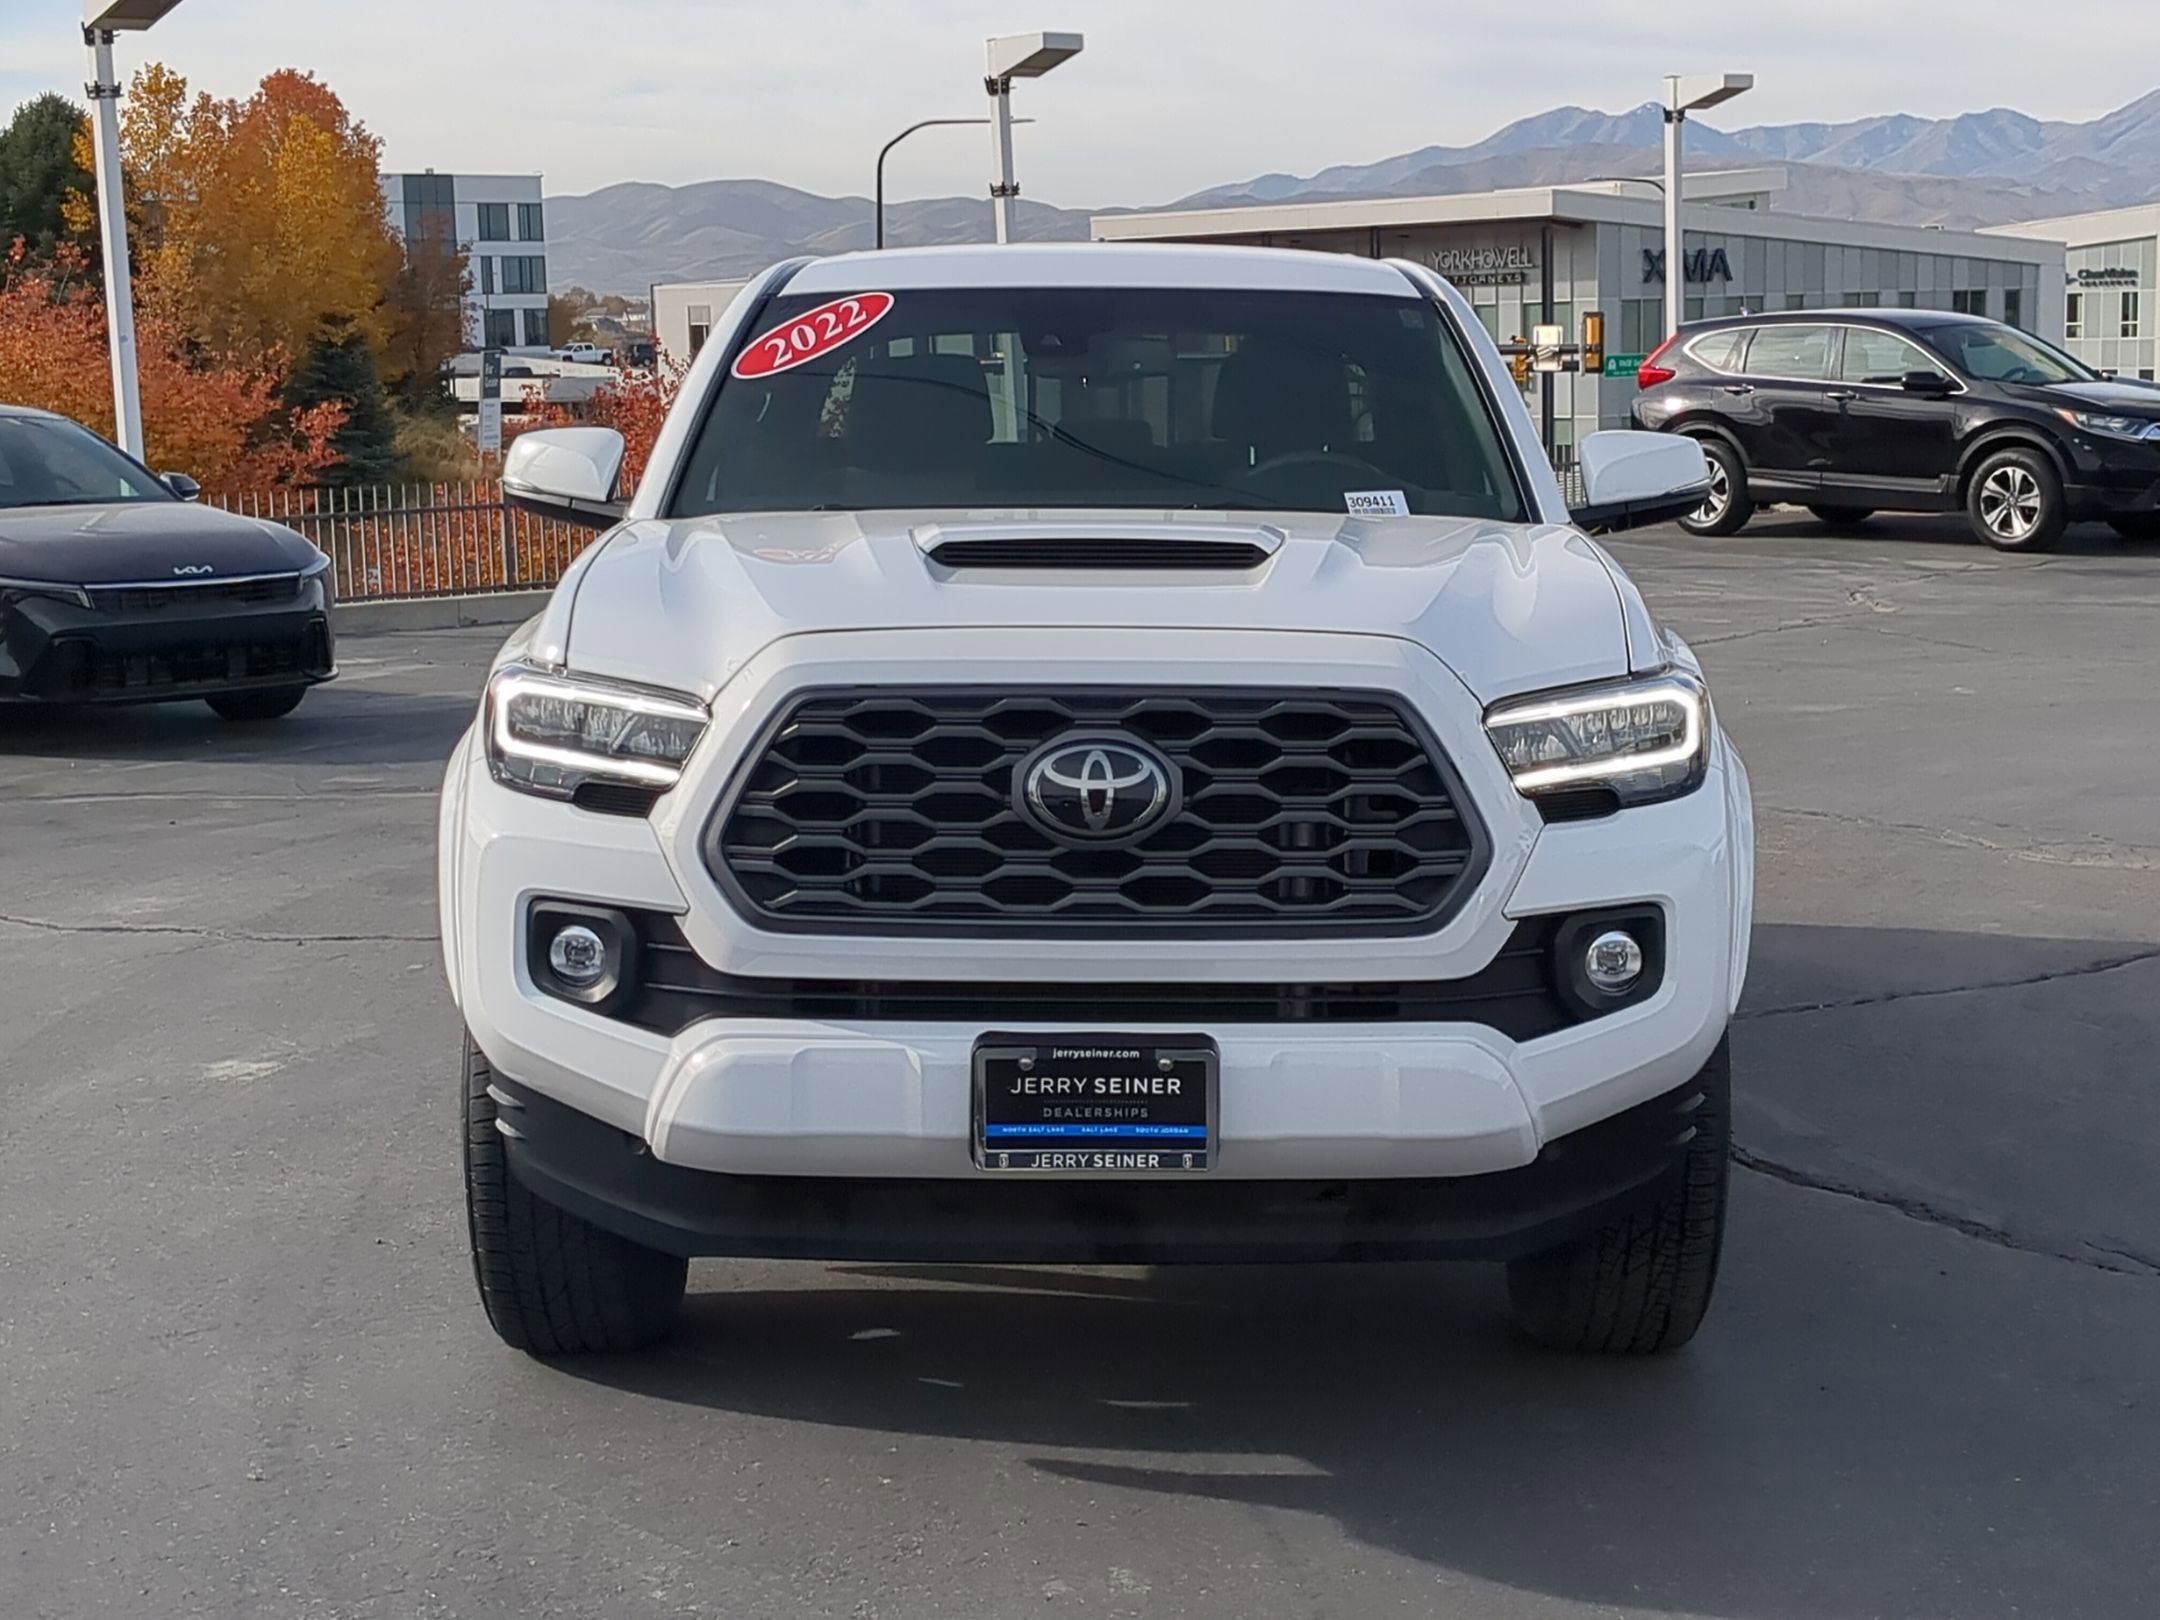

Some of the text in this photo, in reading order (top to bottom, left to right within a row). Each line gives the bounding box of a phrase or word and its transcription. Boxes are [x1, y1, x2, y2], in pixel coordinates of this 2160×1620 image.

[1643, 248, 1734, 282] XMA
[1447, 273, 1522, 285] TTORNEYS
[764, 300, 867, 368] 2022
[1348, 495, 1395, 508] 309411
[1052, 1047, 1140, 1059] jerryseiner.com
[1010, 1077, 1181, 1095] JERRY SEINER
[1043, 1107, 1149, 1118] DEALERSHIPS
[1031, 1154, 1160, 1168] JERRY SEINER
